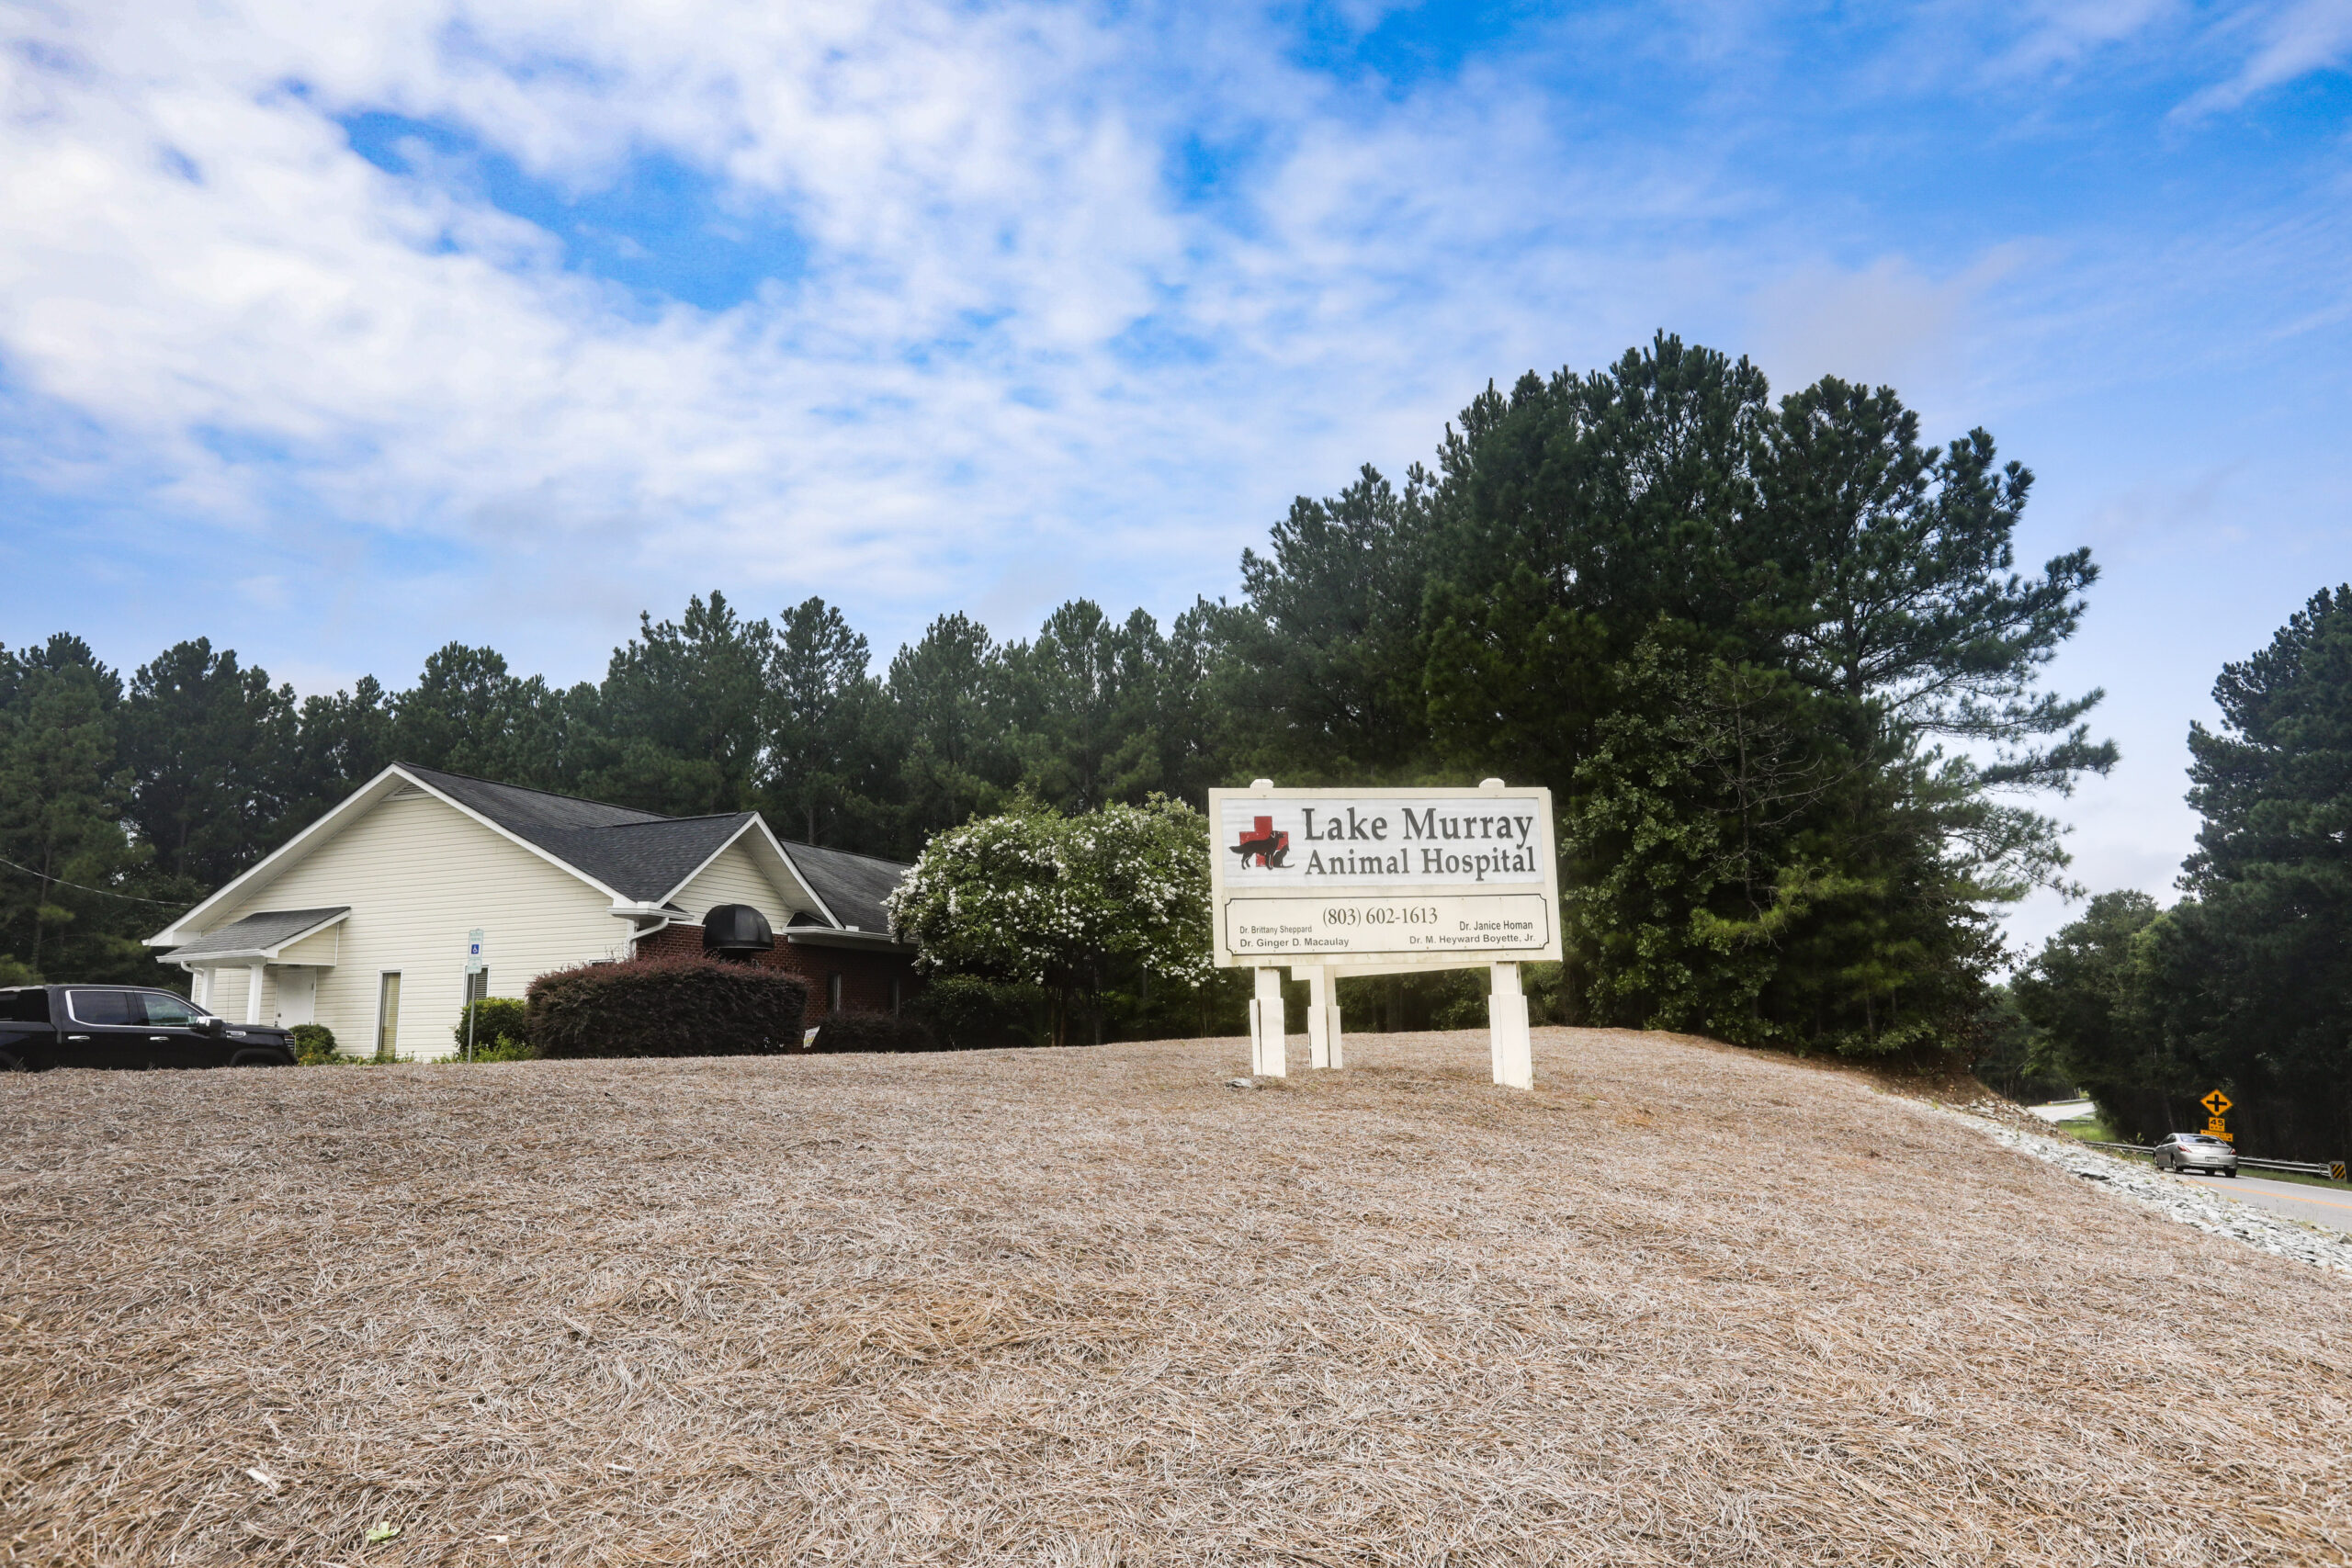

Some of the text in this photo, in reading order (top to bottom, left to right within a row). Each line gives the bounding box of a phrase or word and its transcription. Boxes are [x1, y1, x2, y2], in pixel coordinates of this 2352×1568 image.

[1302, 807, 1533, 850] Lake Murray
[1305, 845, 1536, 882] Animal Hospital
[1323, 907, 1438, 928] (803) 602-1613
[1239, 925, 1313, 935] Dr. Brittany Sheppard
[1459, 919, 1533, 931] Dr. Janice Homan
[1239, 937, 1350, 948] Dr. Ginger D. Macaulay
[1409, 933, 1536, 944] Dr. M. Heyward Boyette, Jr.
